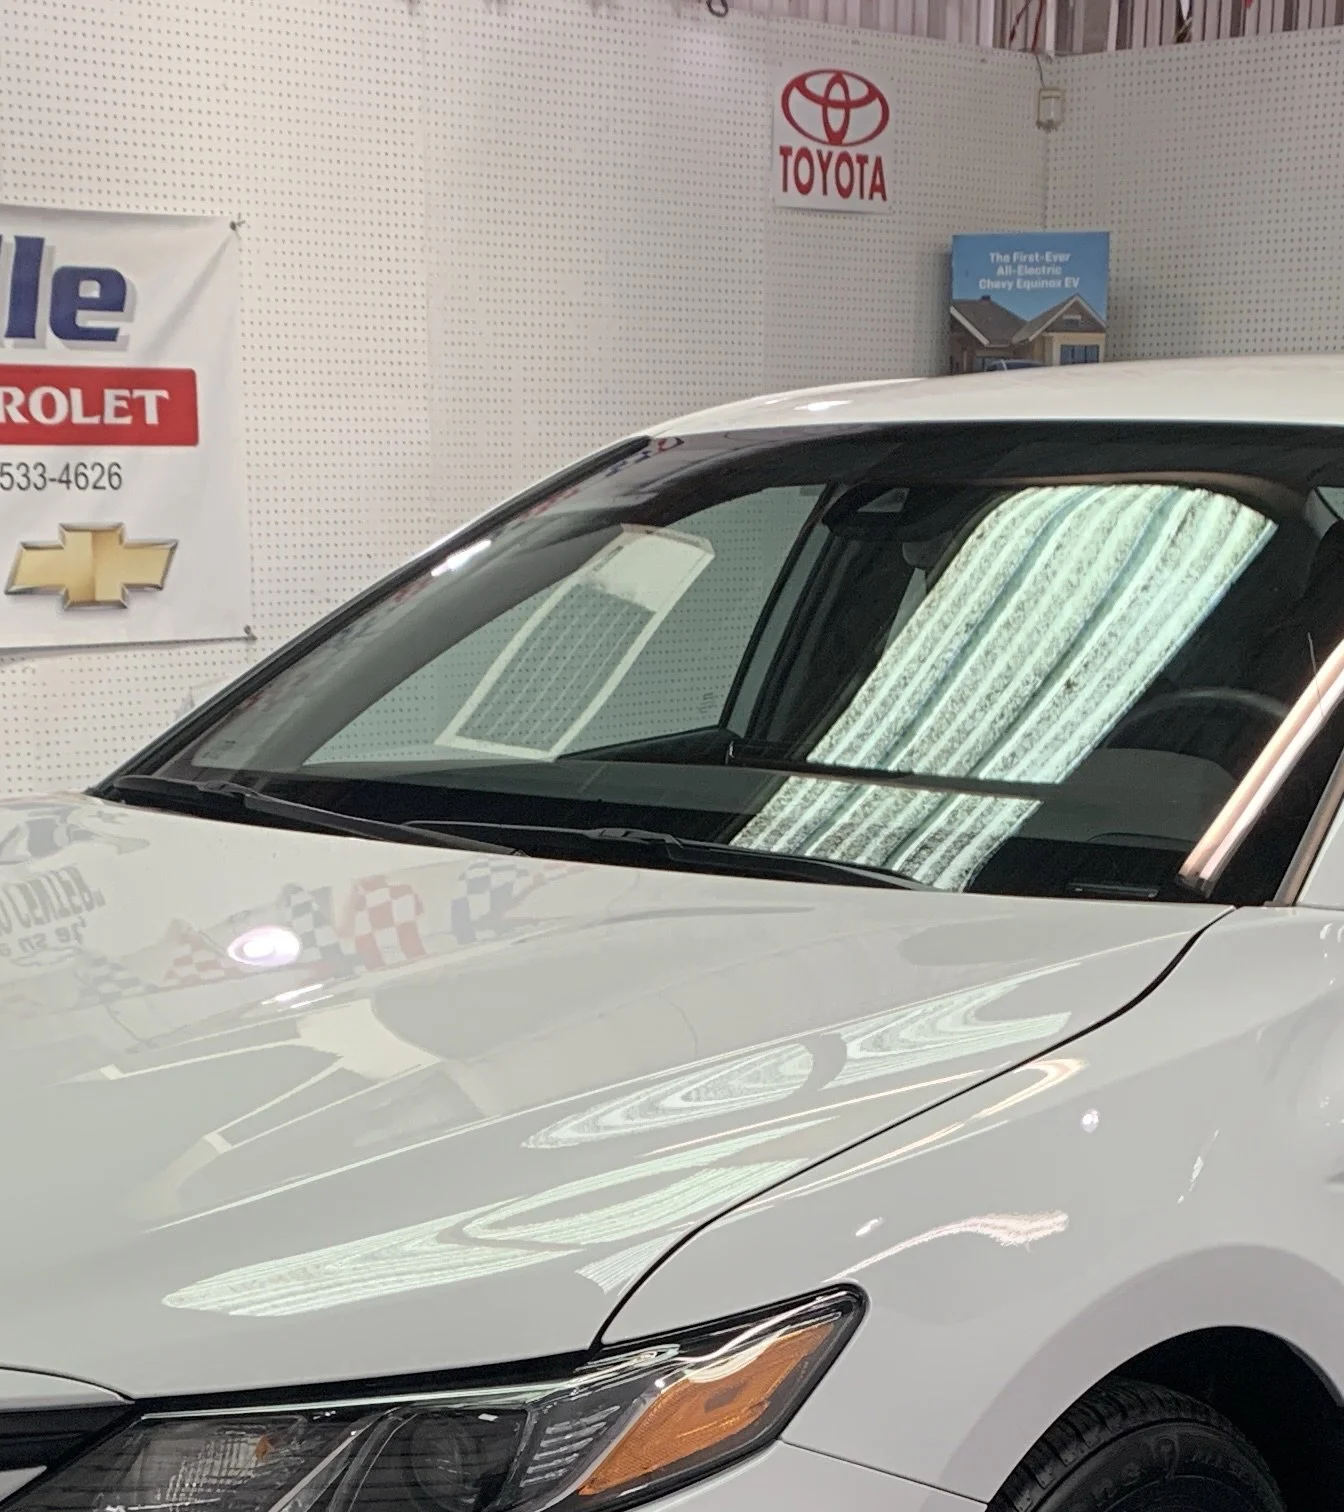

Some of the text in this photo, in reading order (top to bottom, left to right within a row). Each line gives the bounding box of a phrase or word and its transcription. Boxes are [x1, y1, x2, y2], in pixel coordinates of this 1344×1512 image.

[779, 145, 888, 202] TOYOTA
[989, 251, 1071, 263] The First-Ever
[996, 265, 1062, 277] All-Electric
[979, 277, 1080, 291] Chevy Equinox EV
